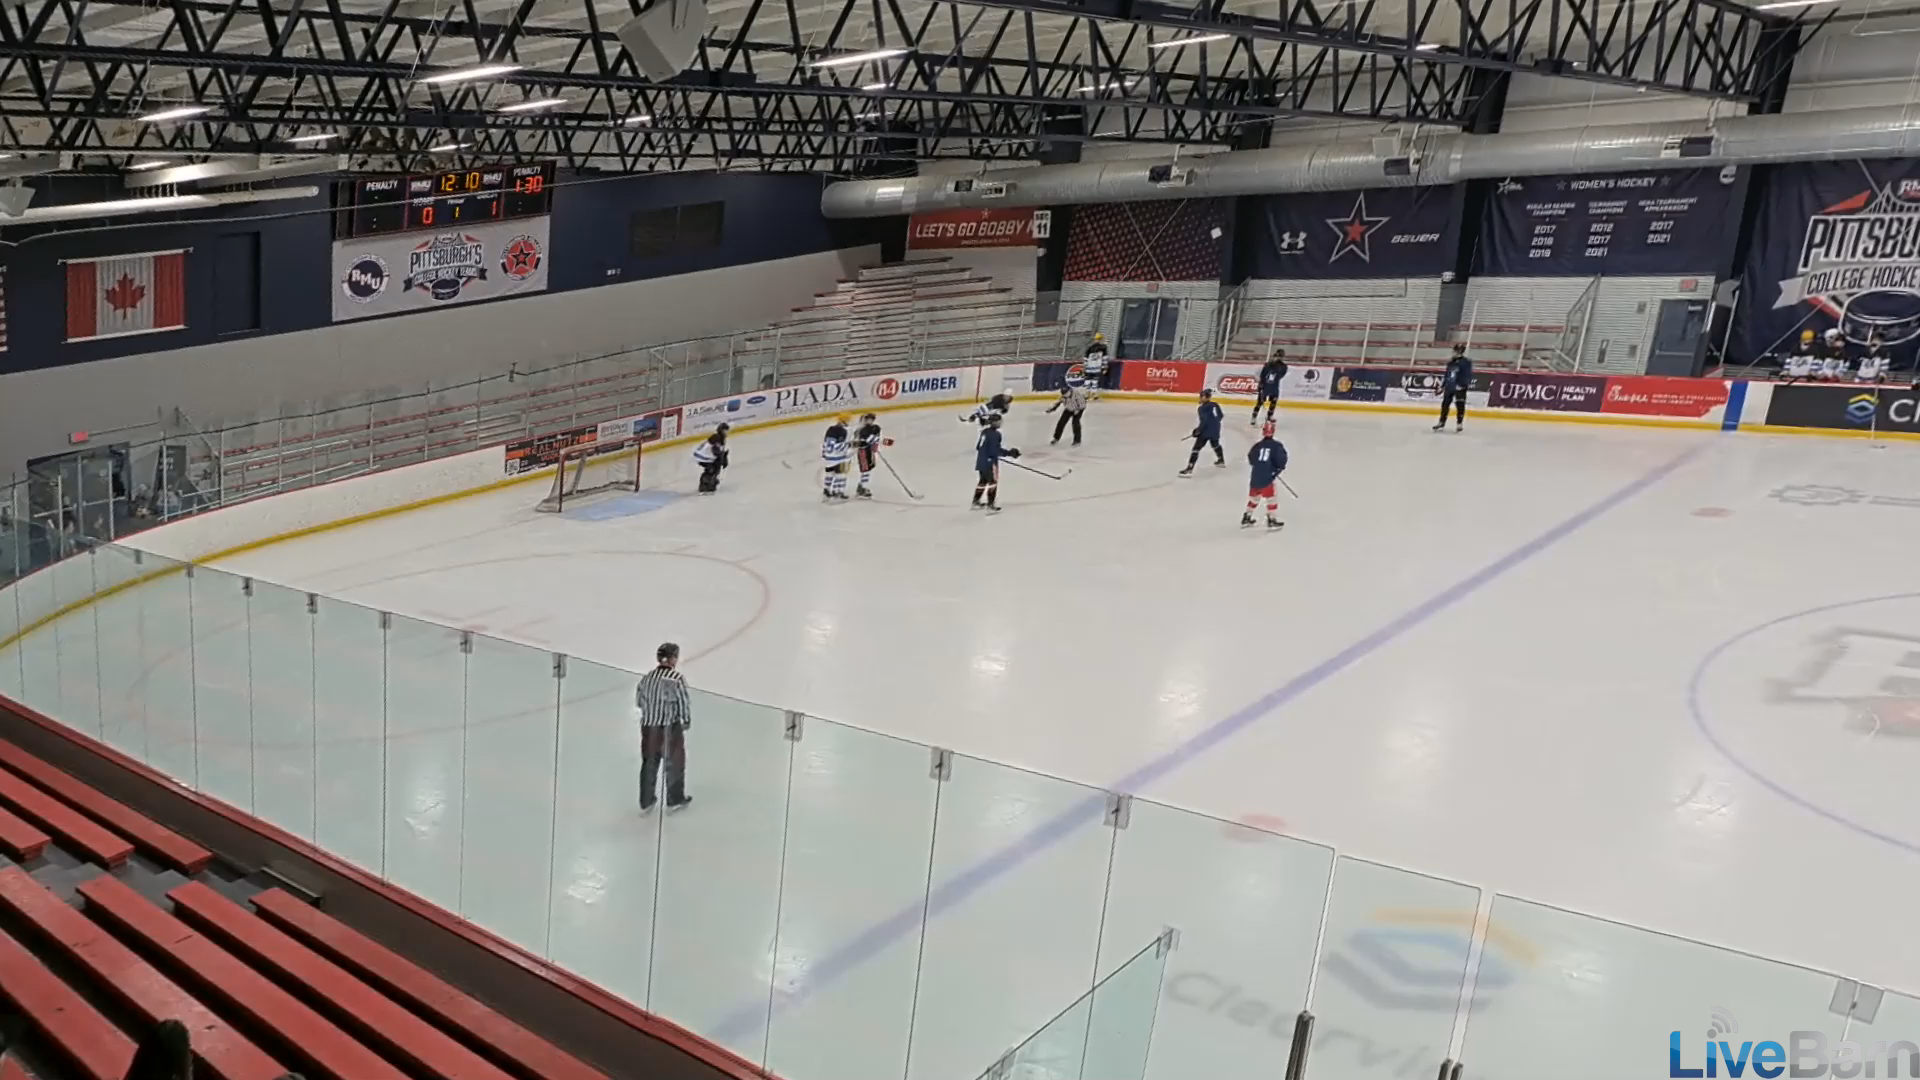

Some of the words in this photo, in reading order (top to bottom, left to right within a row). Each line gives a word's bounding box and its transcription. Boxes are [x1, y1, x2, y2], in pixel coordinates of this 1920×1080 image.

[513, 166, 541, 176] PENALTY
[366, 180, 398, 191] PENALTY
[1570, 178, 1615, 190] WOMEN'S
[1616, 177, 1656, 188] HOCKEY
[916, 218, 956, 238] LEET'S
[957, 221, 977, 236] GO
[978, 219, 1024, 236] BOBBY
[1036, 222, 1048, 235] 11
[1534, 225, 1556, 234] 2017
[1650, 221, 1674, 230] 2017
[1391, 233, 1440, 243] BAUER
[1588, 235, 1610, 245] 2017
[1802, 216, 1920, 269] PITTSBU
[410, 245, 483, 273] PITTSBURGH'S
[352, 269, 380, 289] RMU
[1807, 272, 1866, 295] COLLEGE
[1872, 266, 1920, 289] HOCKE
[1146, 367, 1178, 378] Ehrlich
[878, 384, 897, 397] 84
[901, 376, 957, 393] LUMBER
[1499, 383, 1557, 400] UPMC
[1562, 386, 1597, 395] HEALTH
[775, 381, 857, 409] PIADA
[1561, 393, 1585, 401] PLAN
